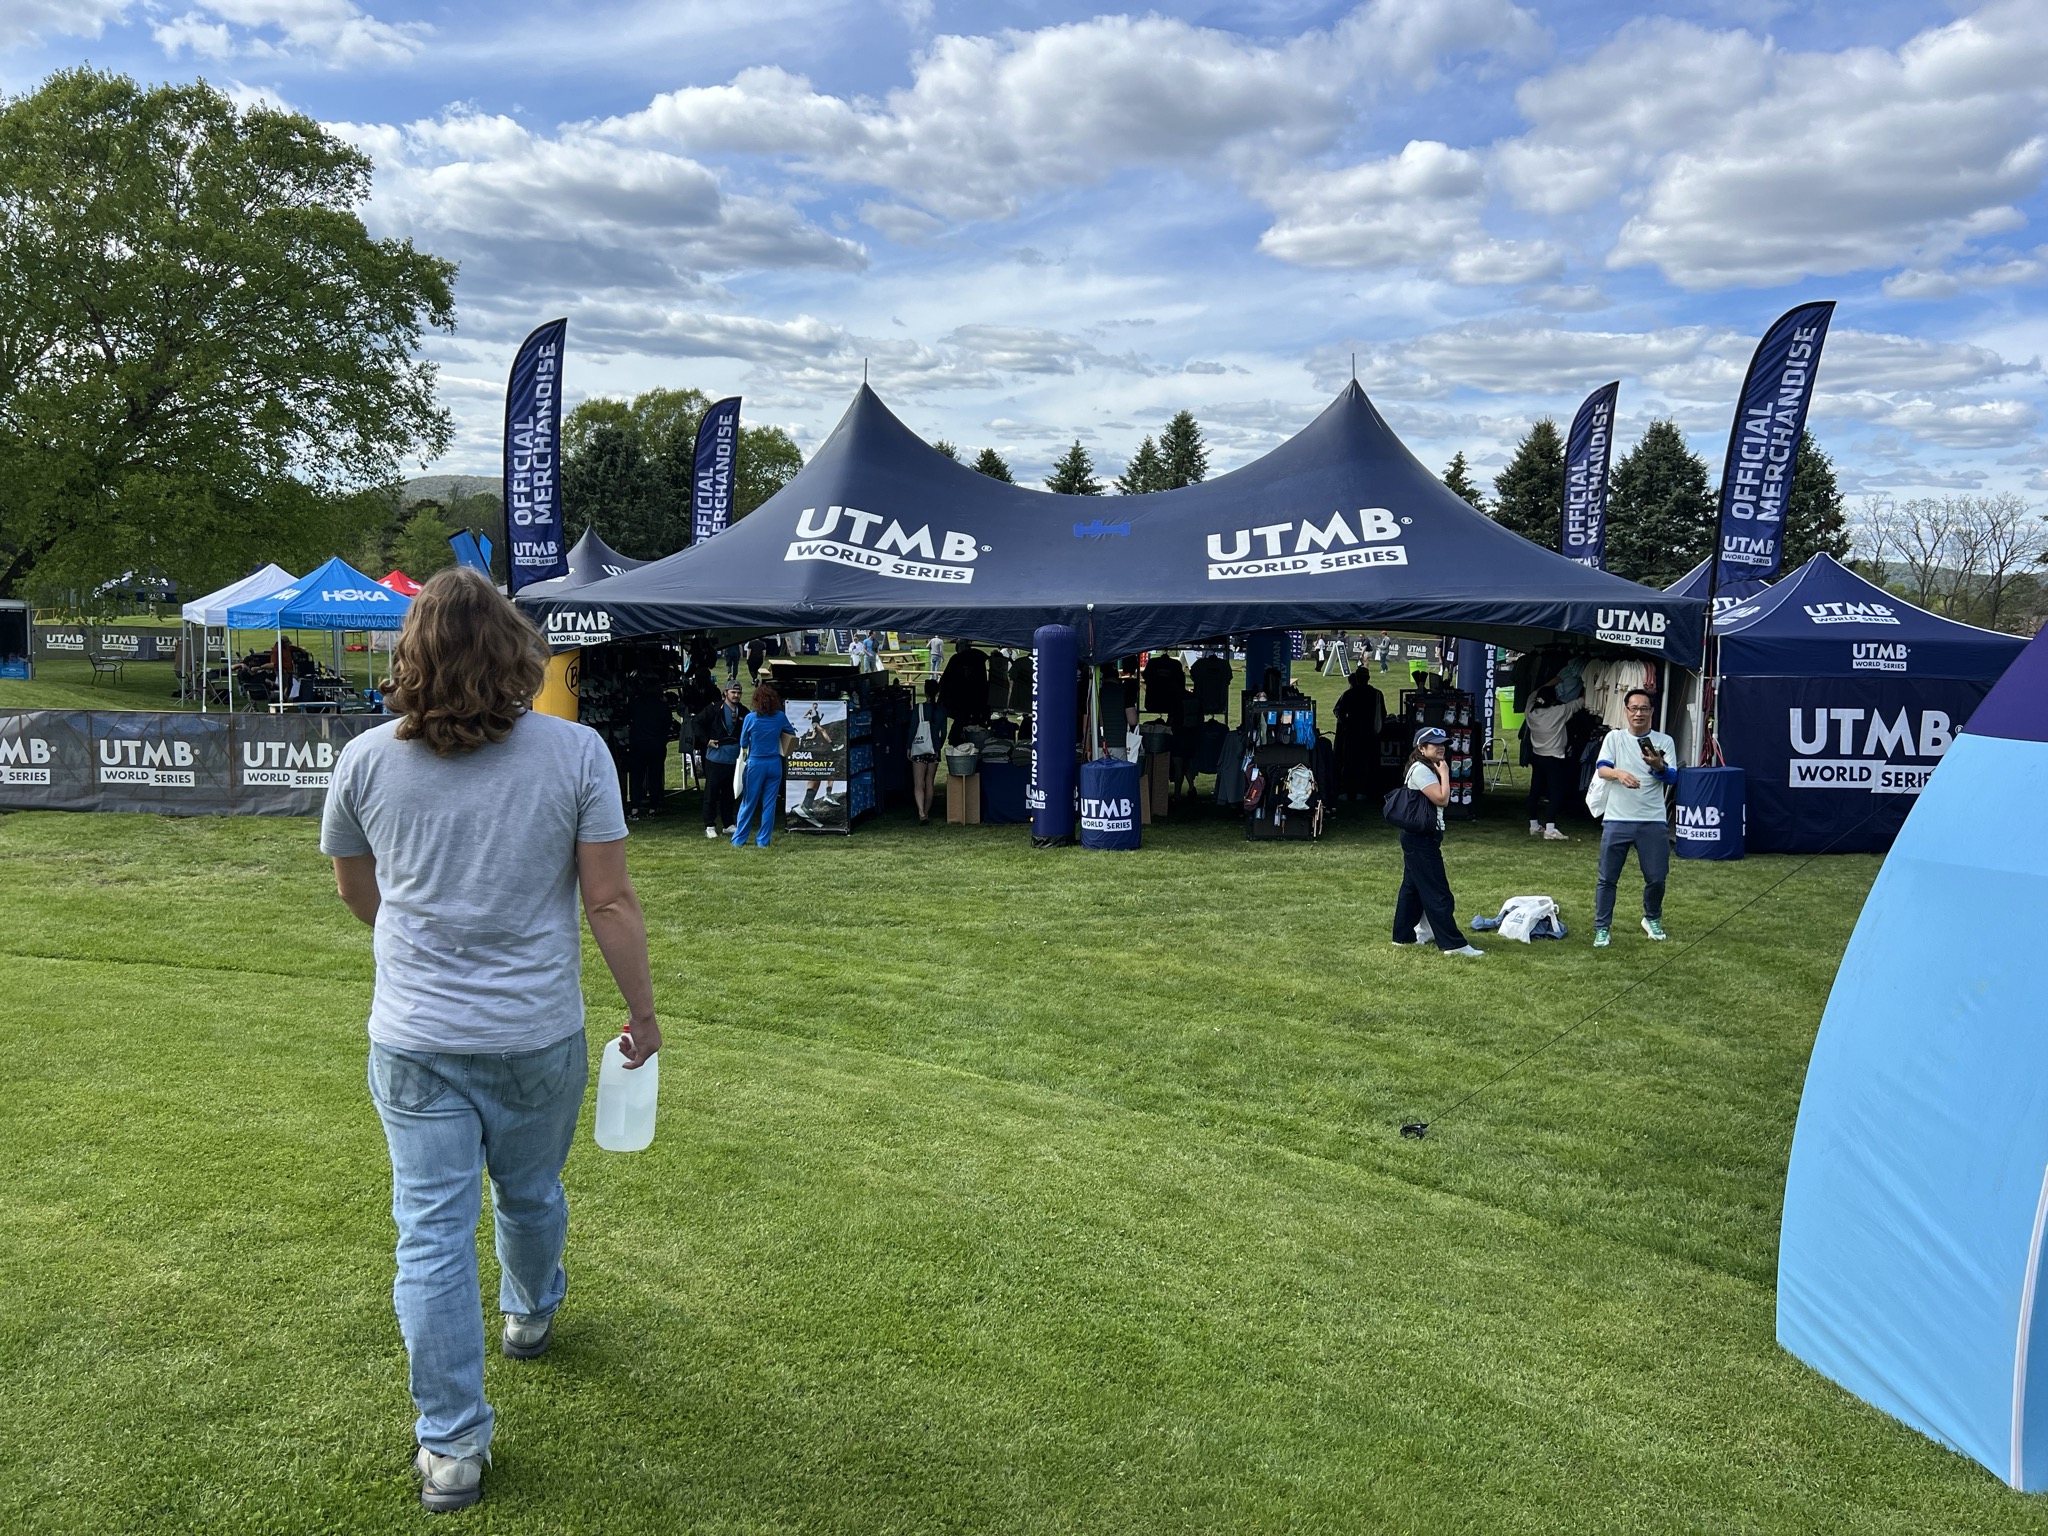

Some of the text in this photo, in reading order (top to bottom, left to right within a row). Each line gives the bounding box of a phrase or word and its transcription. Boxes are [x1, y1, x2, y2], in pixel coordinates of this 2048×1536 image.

[1756, 326, 1817, 522] MERCHANDISE
[533, 342, 556, 525] MERCHANDISE
[1731, 401, 1773, 520] OFFICIAL
[513, 415, 534, 526] OFFICIAL
[712, 414, 733, 535] ERCHANDISE
[1587, 402, 1609, 545] MERCHANDISE
[1568, 460, 1588, 546] OFFICIAL
[513, 541, 558, 556] UTMB
[1724, 535, 1775, 555] UTMB
[538, 557, 557, 565] SERIES
[796, 544, 966, 580] WORLD SERIES
[1216, 550, 1399, 576] WORLD SERIES
[1572, 556, 1600, 567] TMB
[1724, 553, 1750, 561] WORLD
[321, 588, 390, 602] HOKA
[301, 612, 400, 627] FLY HUMAN
[1861, 616, 1896, 624] SERIES
[46, 634, 84, 644] UTMB
[102, 634, 139, 645] UTMB
[551, 634, 609, 643] WORLD SERIES
[1599, 632, 1662, 647] WORLD SERIES
[0, 736, 50, 765] MB
[9, 772, 47, 781] SERIES
[105, 770, 191, 784] WORLD SERIES
[247, 772, 329, 785] WORLD SERIES
[1797, 766, 1931, 788] WORLD SERIE
[1106, 821, 1131, 829] SERIES
[1690, 830, 1718, 838] SERIES
